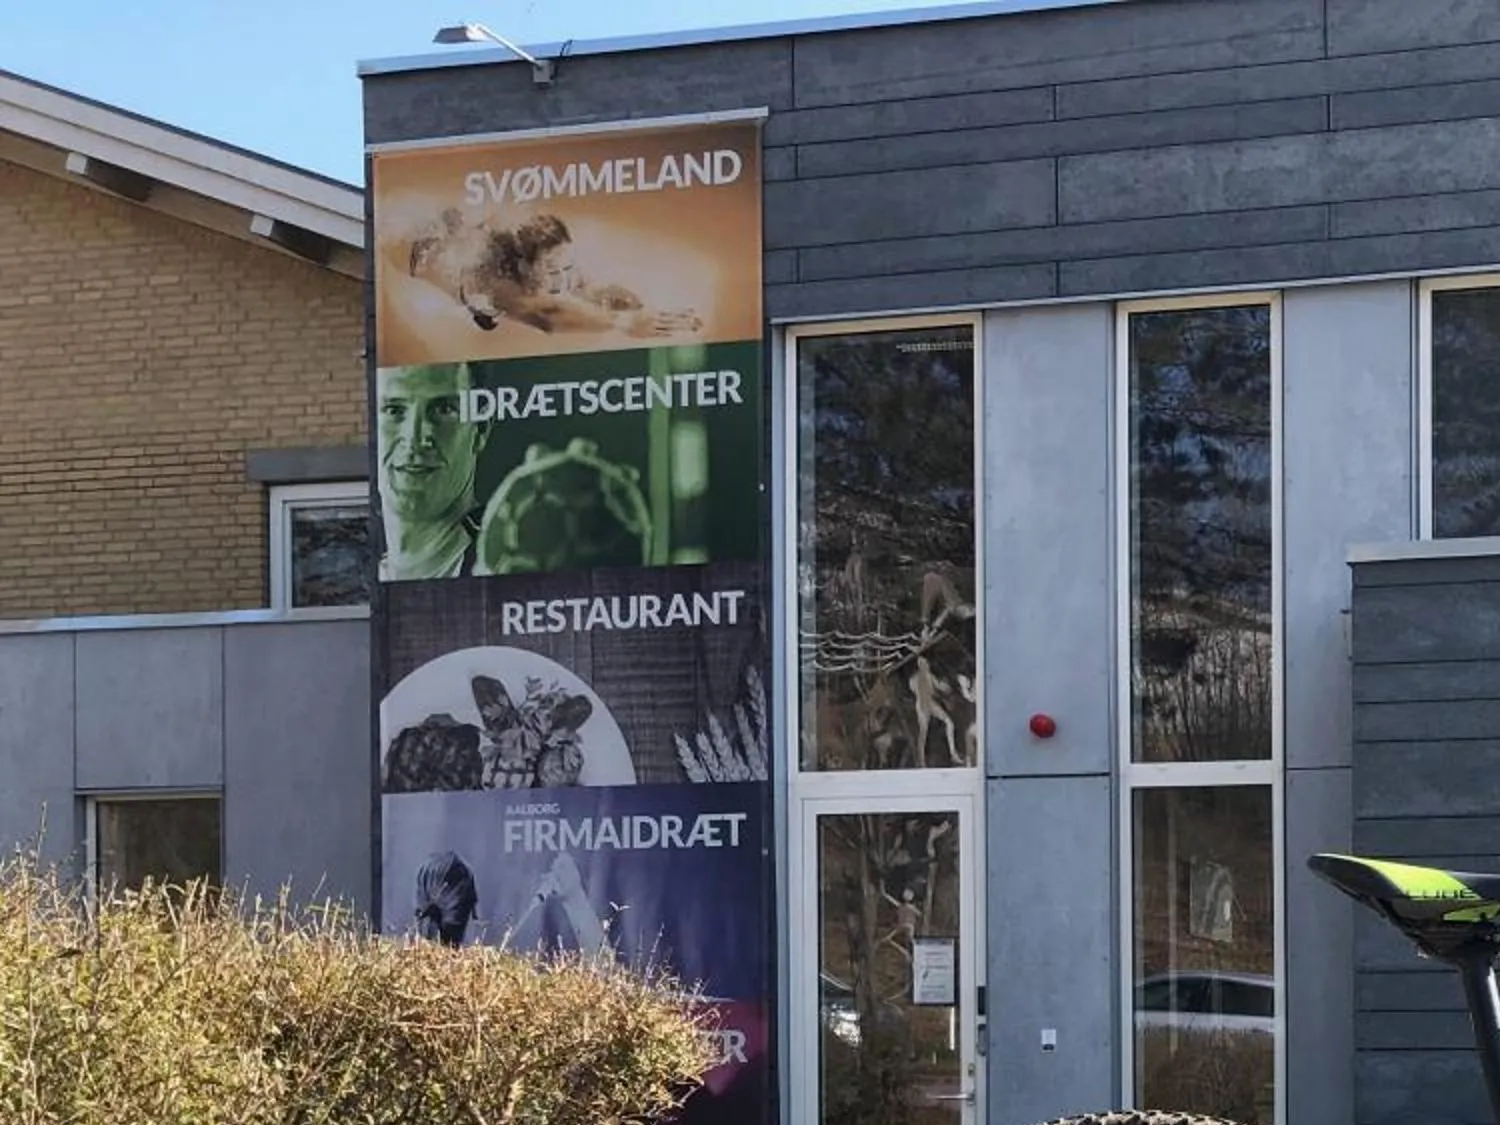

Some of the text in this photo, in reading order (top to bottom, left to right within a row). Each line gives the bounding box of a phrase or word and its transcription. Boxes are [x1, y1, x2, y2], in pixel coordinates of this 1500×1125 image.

[464, 148, 743, 205] SVØMMELAND
[459, 370, 743, 424] IDRÆTSCENTER
[501, 590, 745, 636] RESTAURANT
[503, 812, 748, 854] FIRMAIDRÆT
